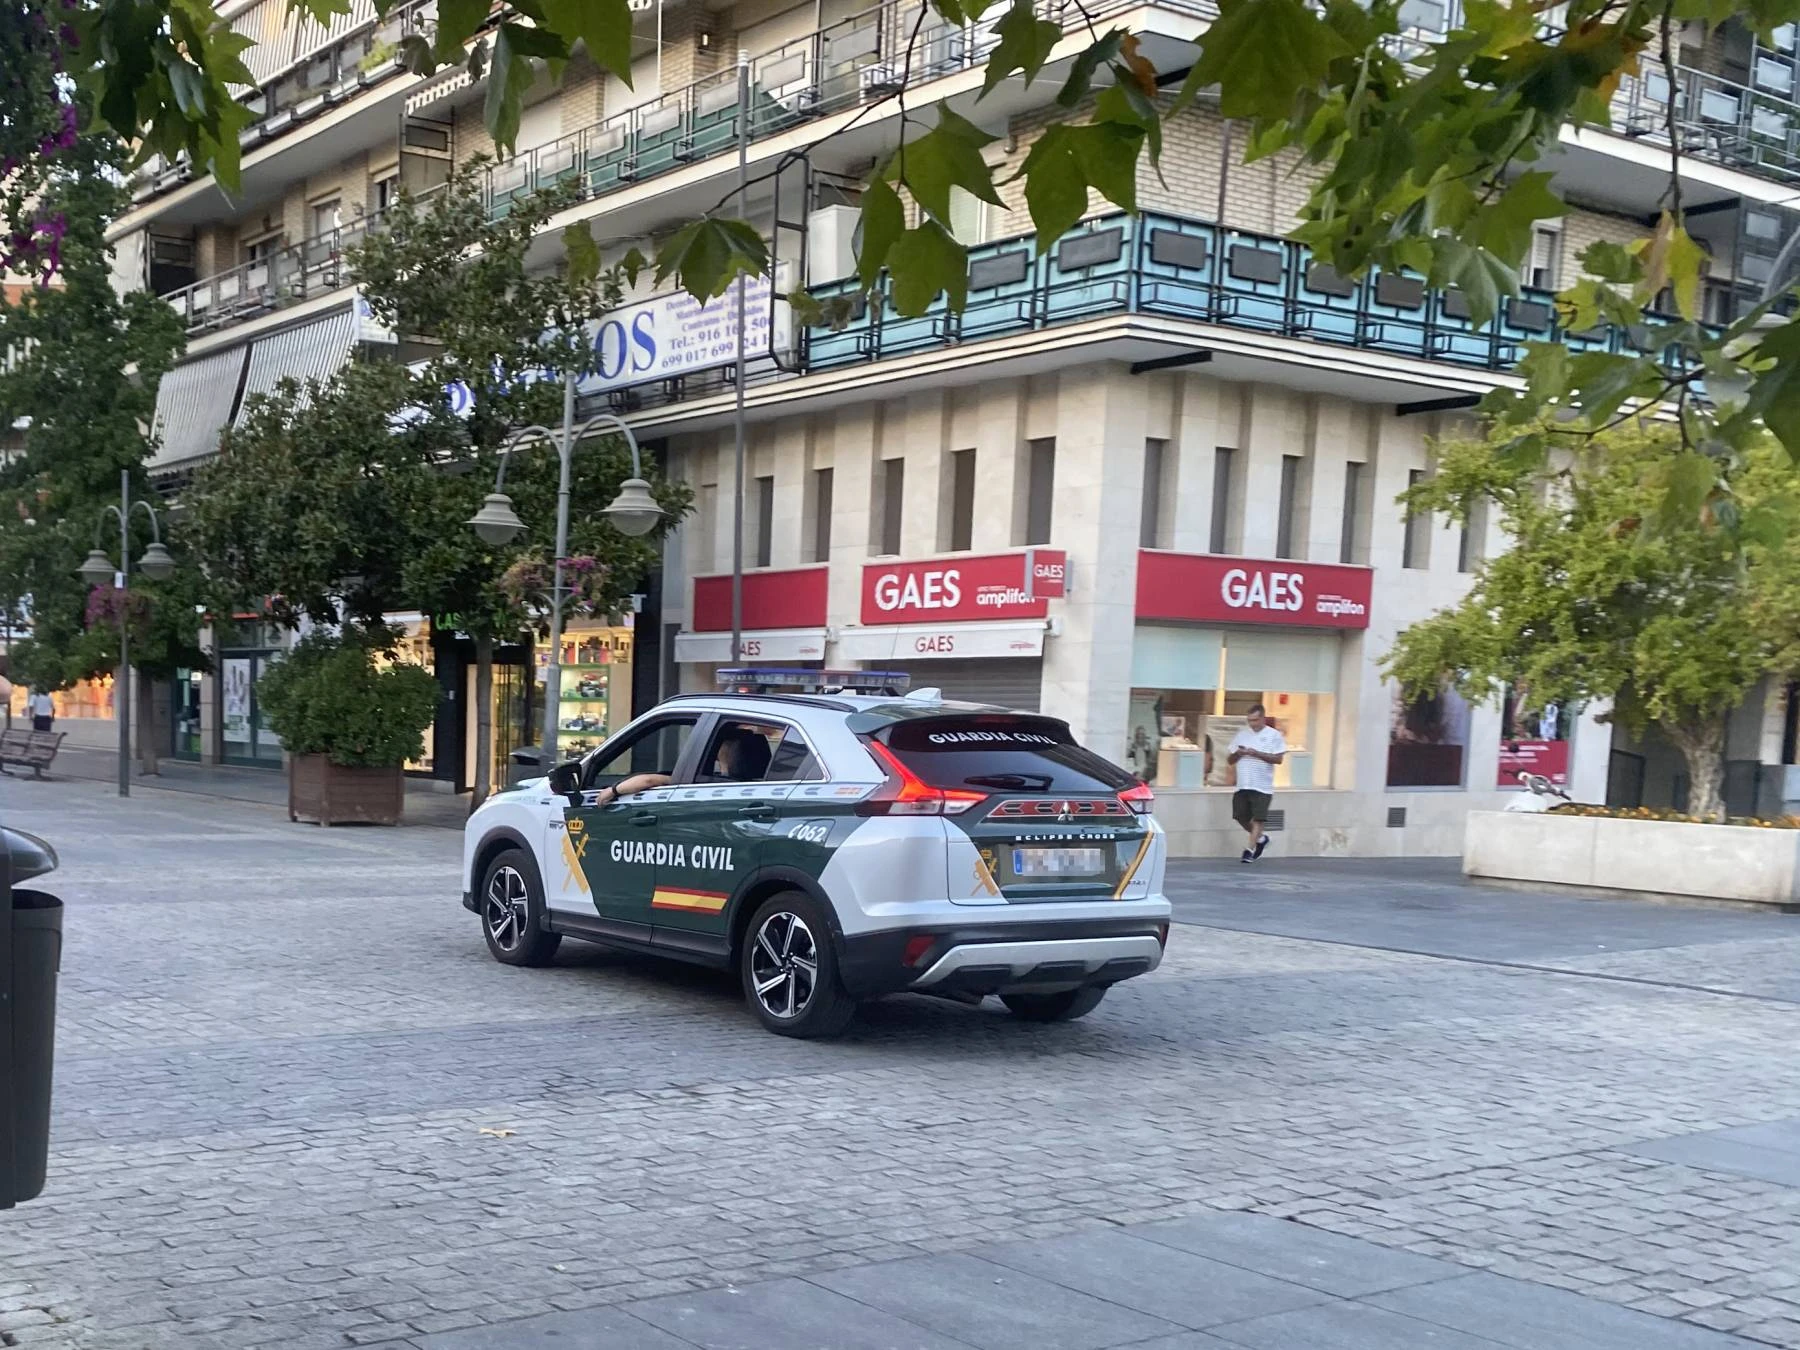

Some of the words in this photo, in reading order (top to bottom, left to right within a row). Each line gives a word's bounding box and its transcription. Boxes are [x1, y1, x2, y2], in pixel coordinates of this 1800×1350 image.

[698, 329, 720, 342] 916
[661, 354, 682, 368] 699
[686, 348, 707, 362] 017
[711, 342, 734, 356] 699
[1034, 564, 1064, 578] GAES
[874, 570, 961, 611] GAES
[1221, 569, 1304, 611] GAES
[1316, 598, 1365, 617] amplifon
[915, 635, 954, 653] GAES
[929, 731, 1014, 744] GUARDIA
[1013, 732, 1058, 745] CIVIL
[610, 839, 686, 867] GUARDIA
[691, 845, 735, 871] CIVIL
